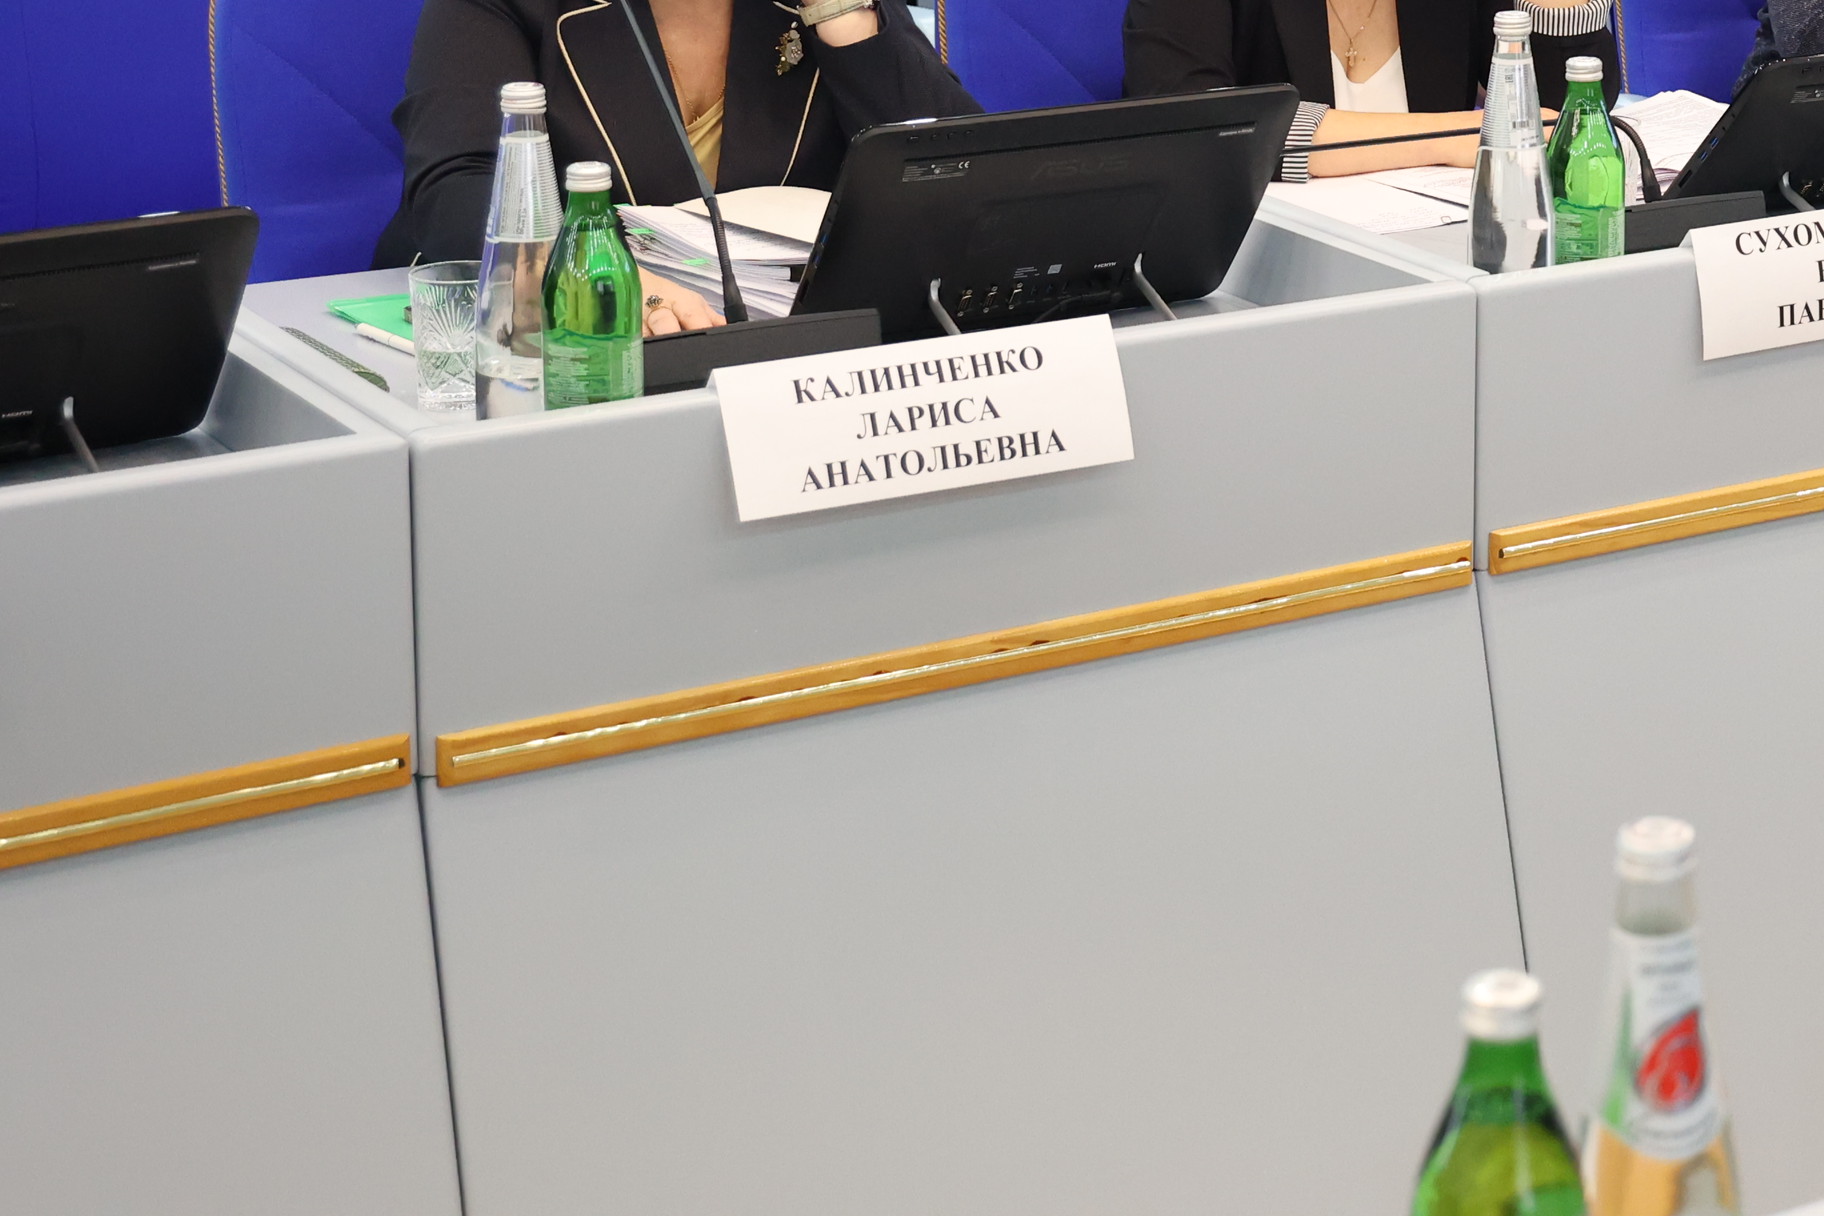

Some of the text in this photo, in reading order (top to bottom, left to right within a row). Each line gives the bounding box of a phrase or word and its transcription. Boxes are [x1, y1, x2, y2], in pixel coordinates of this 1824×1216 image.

[791, 347, 1043, 403] КАЛИНЧЕНКО
[855, 397, 1000, 439] ЛАРИСА
[801, 430, 1065, 492] АНАТОЛЬЕВНА
